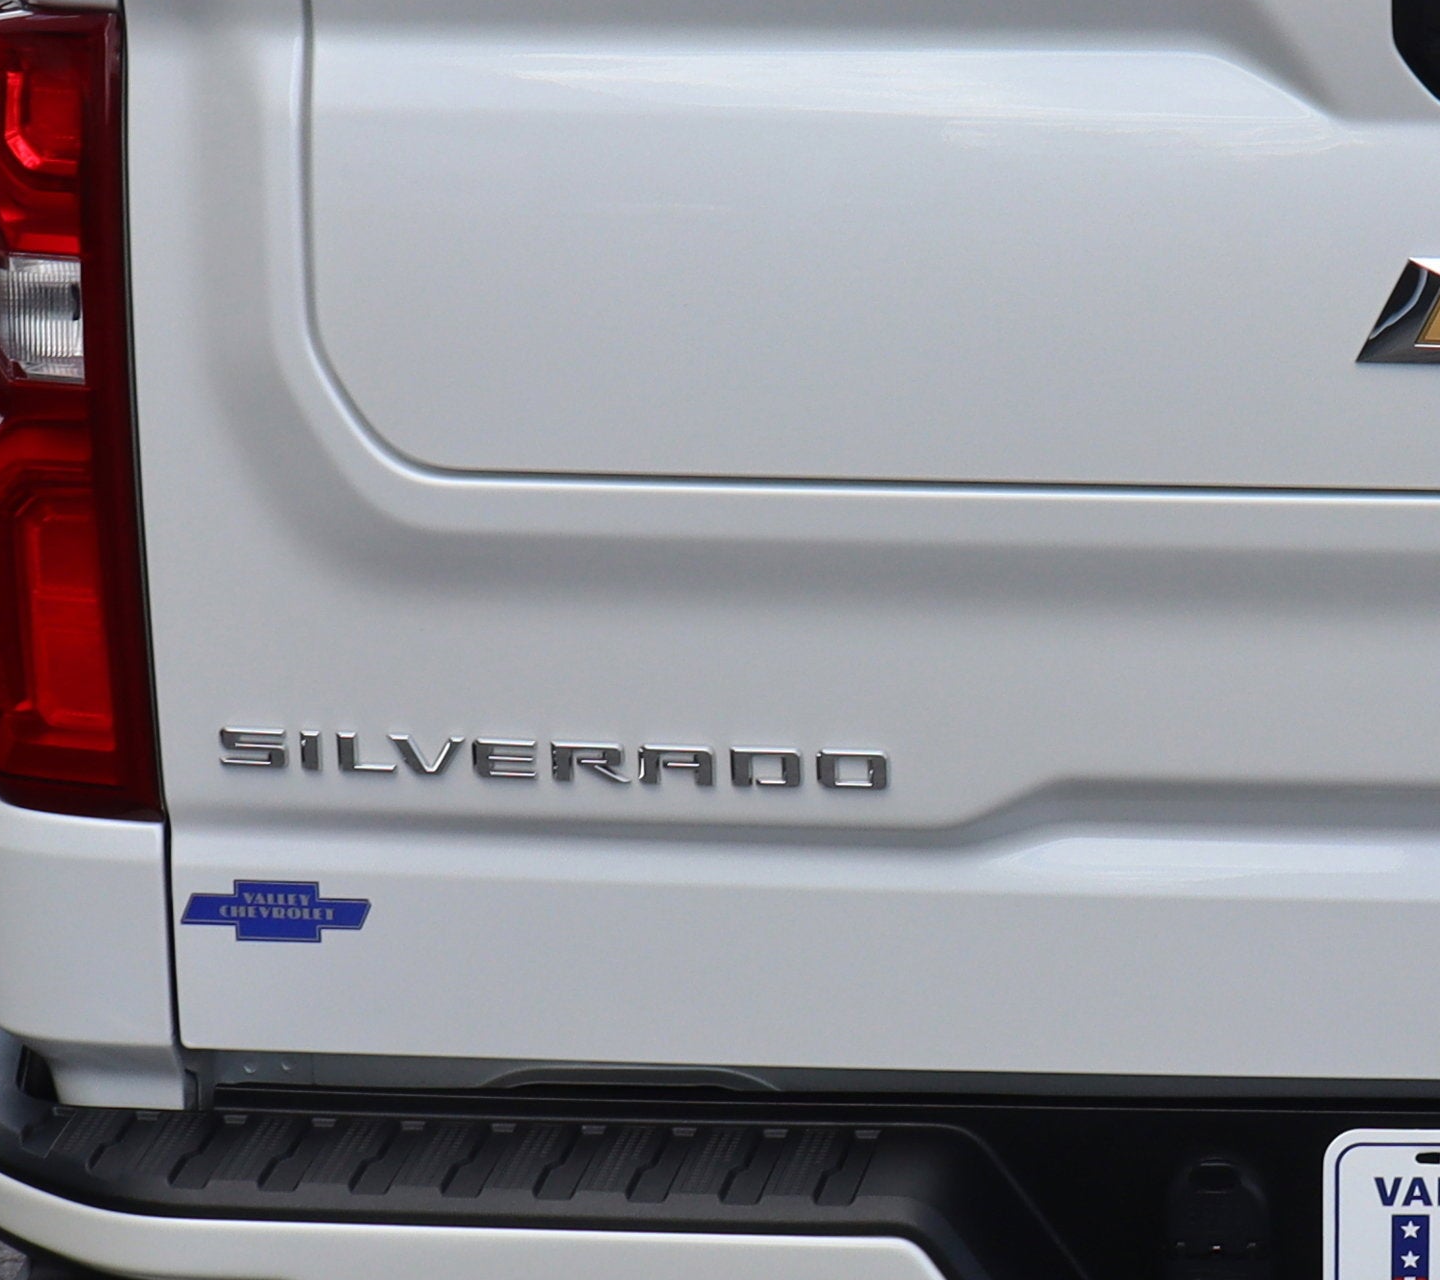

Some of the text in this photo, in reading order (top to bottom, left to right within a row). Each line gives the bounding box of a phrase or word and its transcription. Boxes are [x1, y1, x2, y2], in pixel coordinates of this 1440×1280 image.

[218, 726, 890, 790] SILVERADO
[242, 892, 312, 907] VALLEY
[218, 904, 336, 921] CHEVROLET
